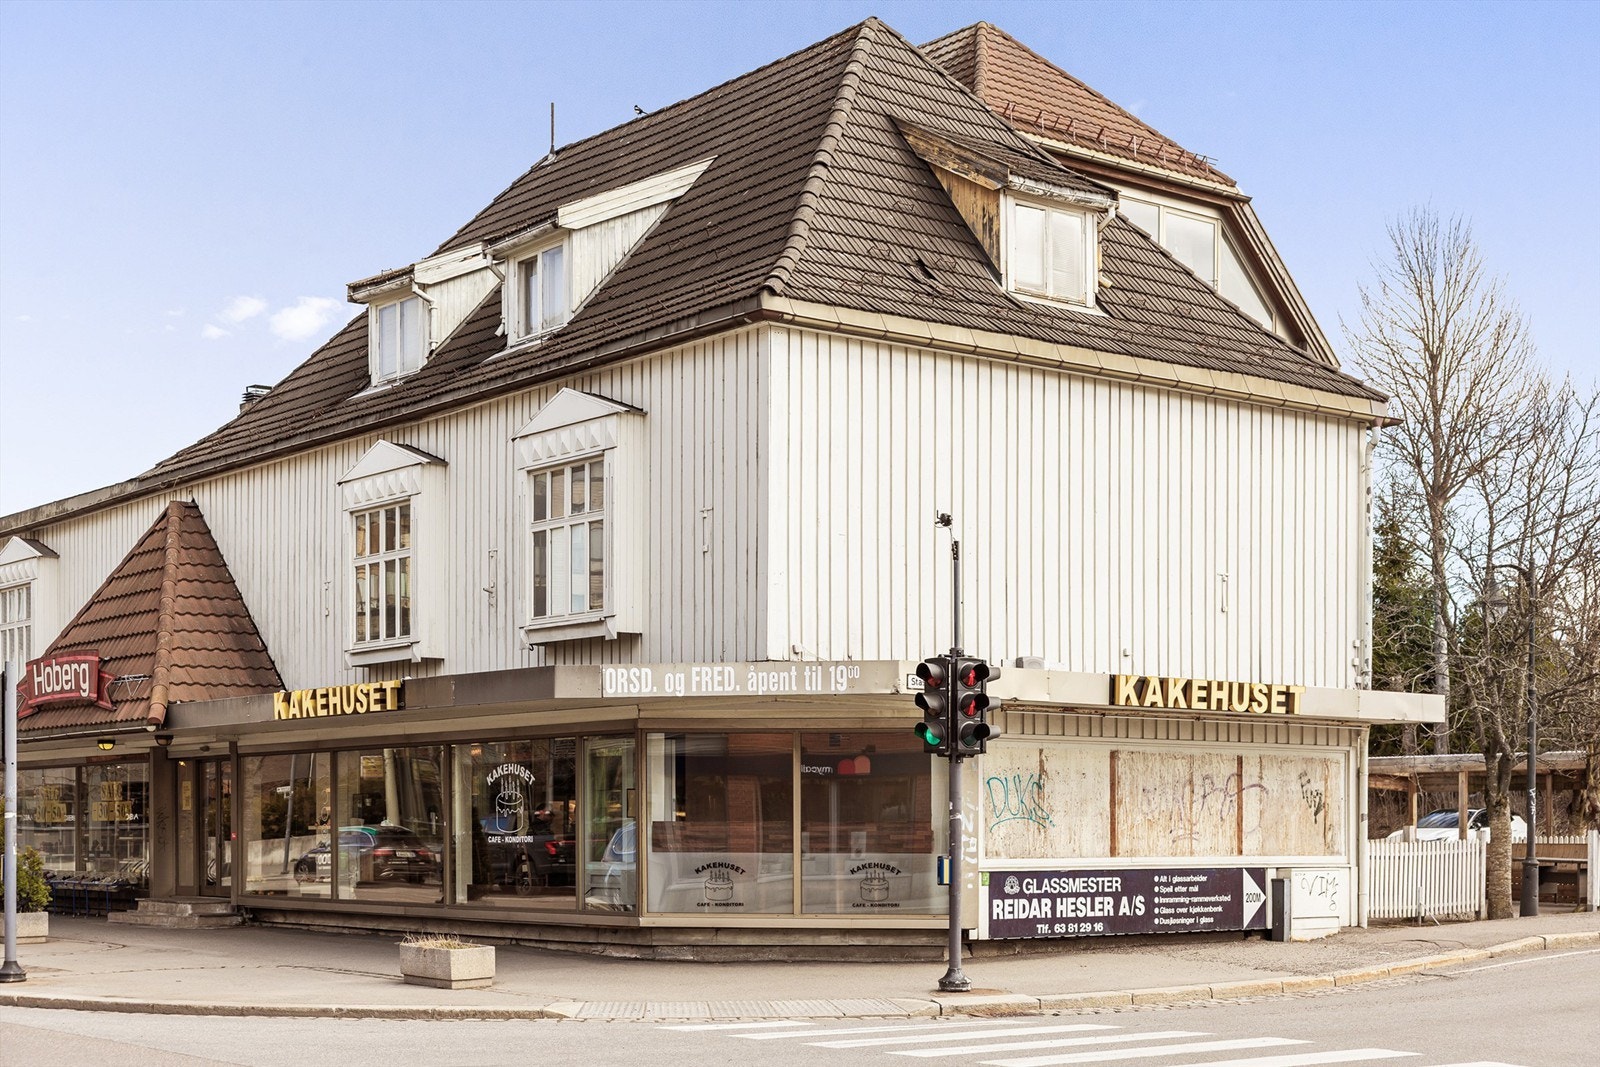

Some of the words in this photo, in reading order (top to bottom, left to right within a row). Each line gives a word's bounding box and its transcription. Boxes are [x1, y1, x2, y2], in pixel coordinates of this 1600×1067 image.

[33, 659, 89, 697] Hoberg
[602, 667, 657, 694] ORSD.
[664, 672, 685, 696] og
[691, 666, 741, 692] FRED.
[747, 665, 797, 695] åpent
[804, 665, 822, 692] til
[273, 680, 401, 720] KAKEHUSET
[1117, 674, 1306, 715] KAKEHUSET
[486, 763, 536, 786] KAKEHUSET
[505, 835, 534, 843] KONDITORI
[694, 862, 746, 875] KAKEHUSET
[850, 862, 902, 876] KAKEHUSET
[1022, 877, 1122, 894] GLASSMESTER
[1172, 875, 1207, 884] glassarbeider
[1159, 885, 1174, 894] Speil
[1174, 885, 1188, 893] etter
[1188, 884, 1199, 892] mål
[1245, 892, 1262, 903] 200M
[992, 898, 1052, 920] REIDAR
[1056, 896, 1115, 918] HESLER
[1118, 895, 1146, 917] A/S
[1159, 906, 1175, 914] Glass
[1199, 916, 1214, 925] glass
[1036, 923, 1051, 934] Tlf.
[1054, 923, 1066, 933] 63
[1068, 923, 1078, 933] 81
[1079, 922, 1092, 933] 29
[1094, 921, 1104, 932] 16
